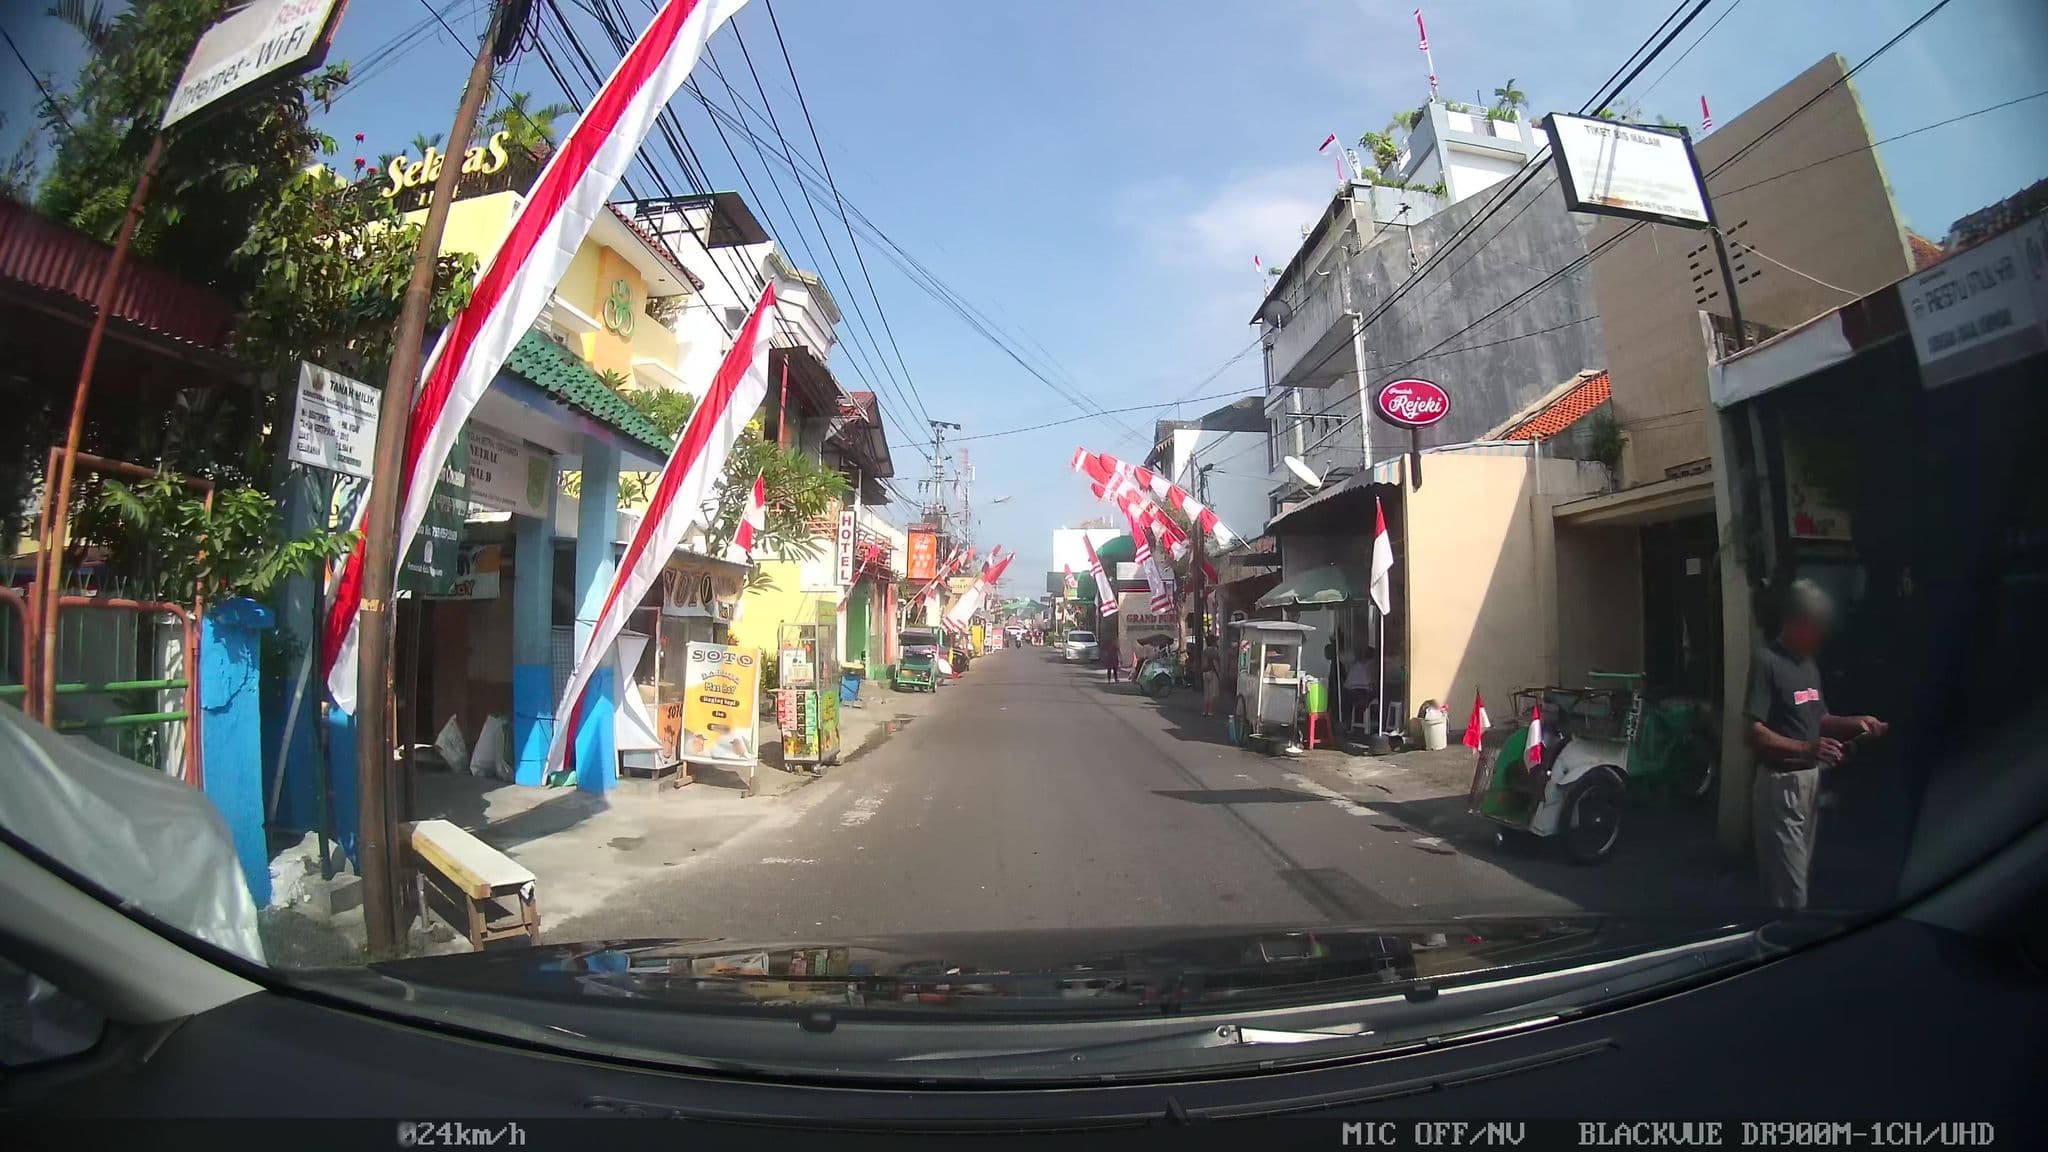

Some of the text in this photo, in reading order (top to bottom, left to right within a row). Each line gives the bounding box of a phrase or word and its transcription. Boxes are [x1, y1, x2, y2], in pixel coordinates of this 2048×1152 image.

[1584, 124, 1611, 138] TIKET
[1630, 131, 1662, 147] MALAM
[330, 380, 354, 399] TANAH
[355, 391, 376, 406] MILIK
[1388, 395, 1443, 420] Rejeki
[839, 515, 852, 581] HOTEL
[692, 650, 754, 667] SOTO
